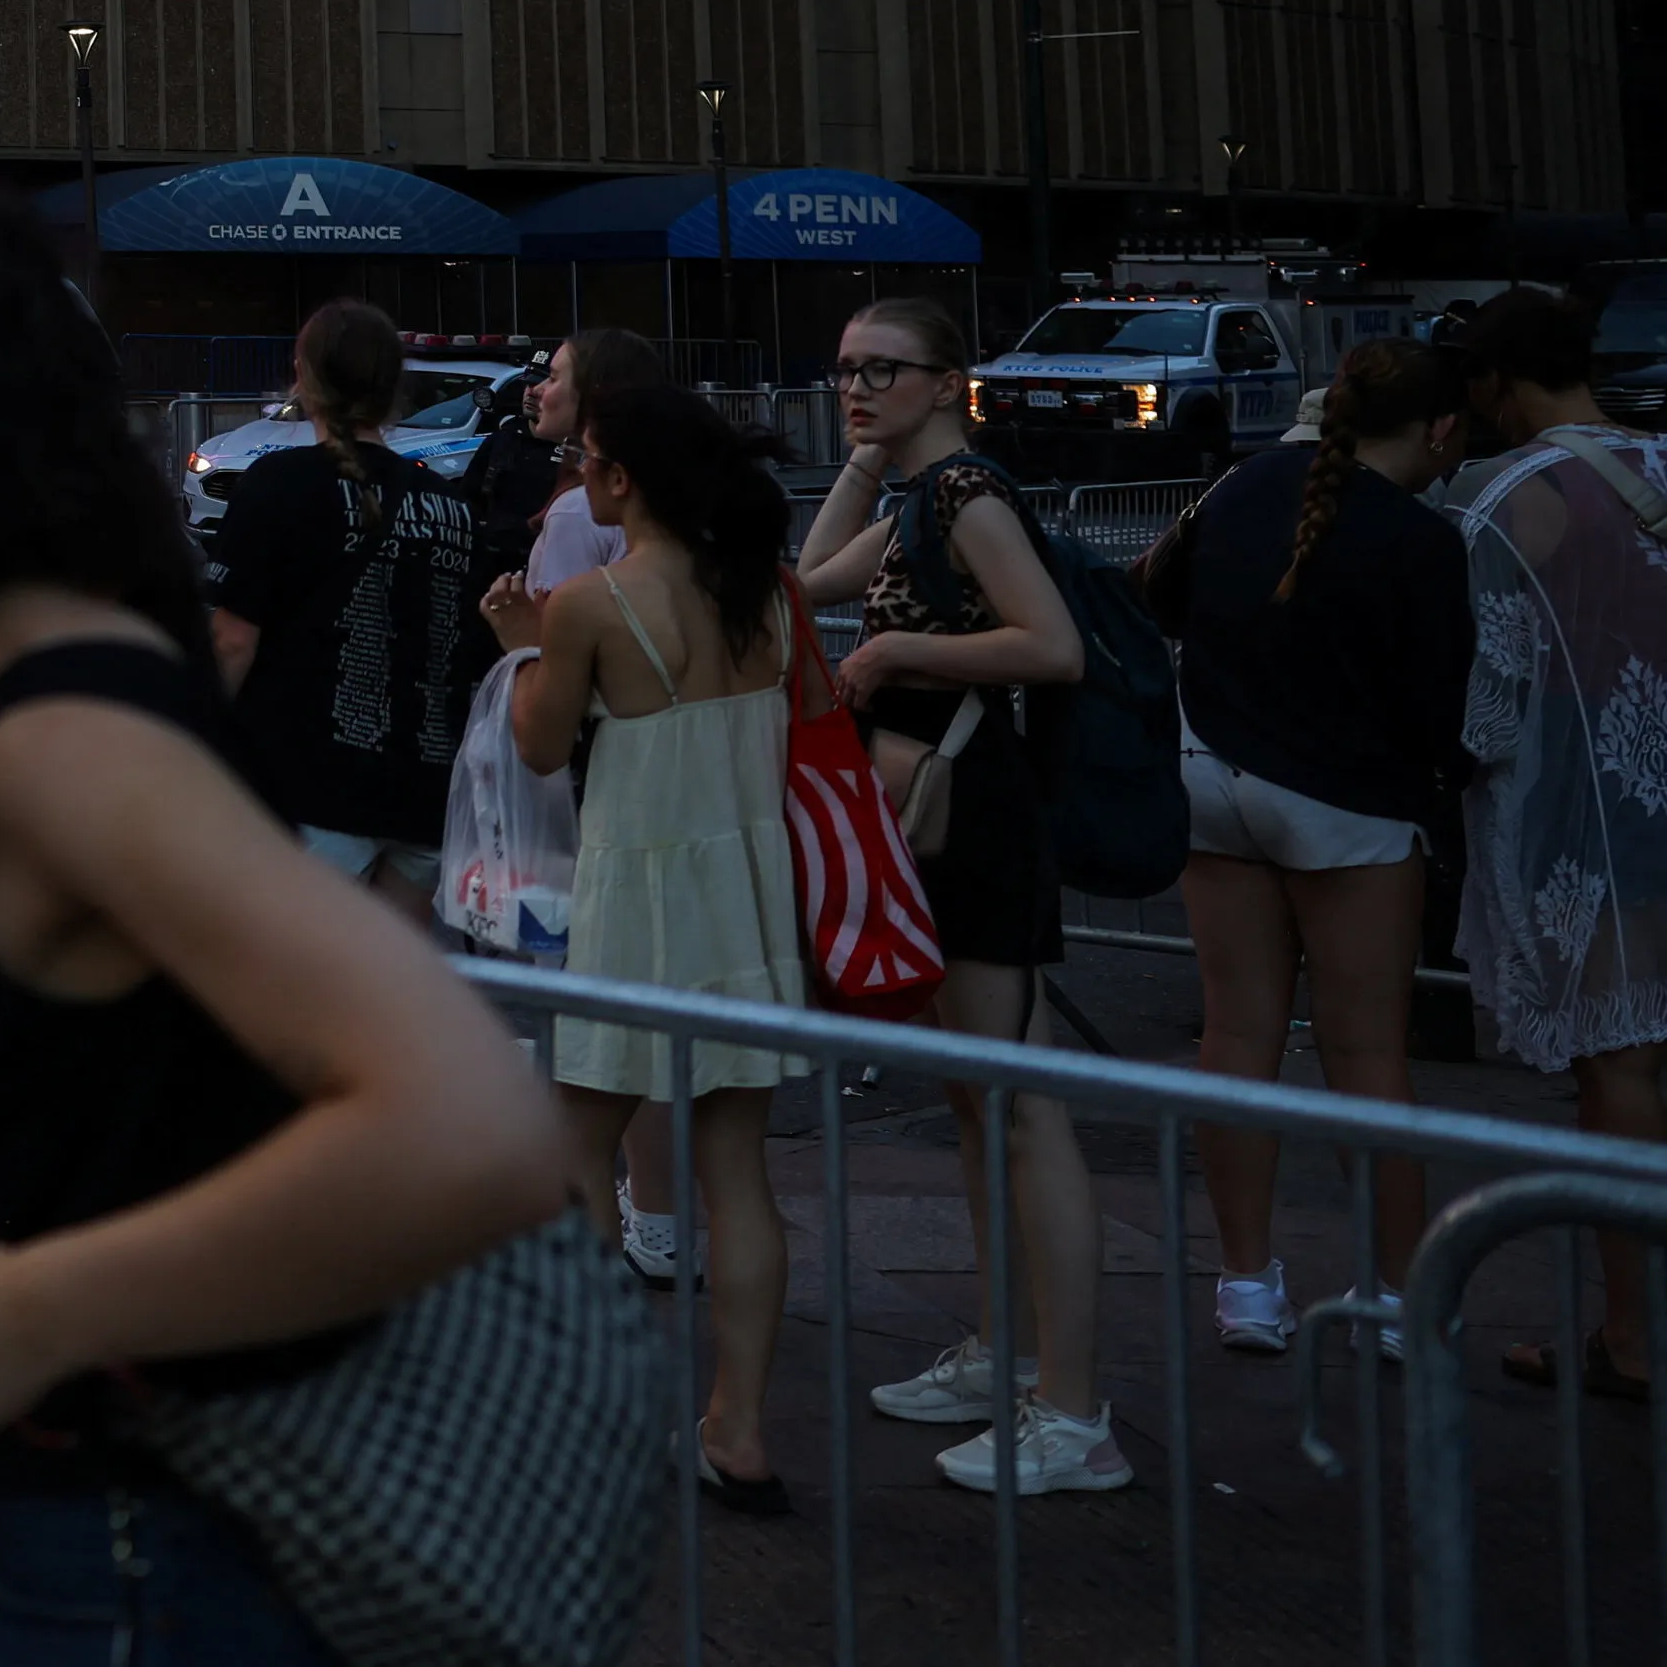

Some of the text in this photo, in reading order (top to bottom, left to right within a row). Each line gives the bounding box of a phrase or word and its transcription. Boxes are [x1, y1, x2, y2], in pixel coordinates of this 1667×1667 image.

[279, 173, 332, 217] A
[753, 192, 899, 225] 4 PENN
[208, 224, 403, 241] CHASE ENTRANCE
[795, 228, 858, 246] WEST
[1048, 365, 1104, 374] POLICE
[429, 545, 471, 575] 2024
